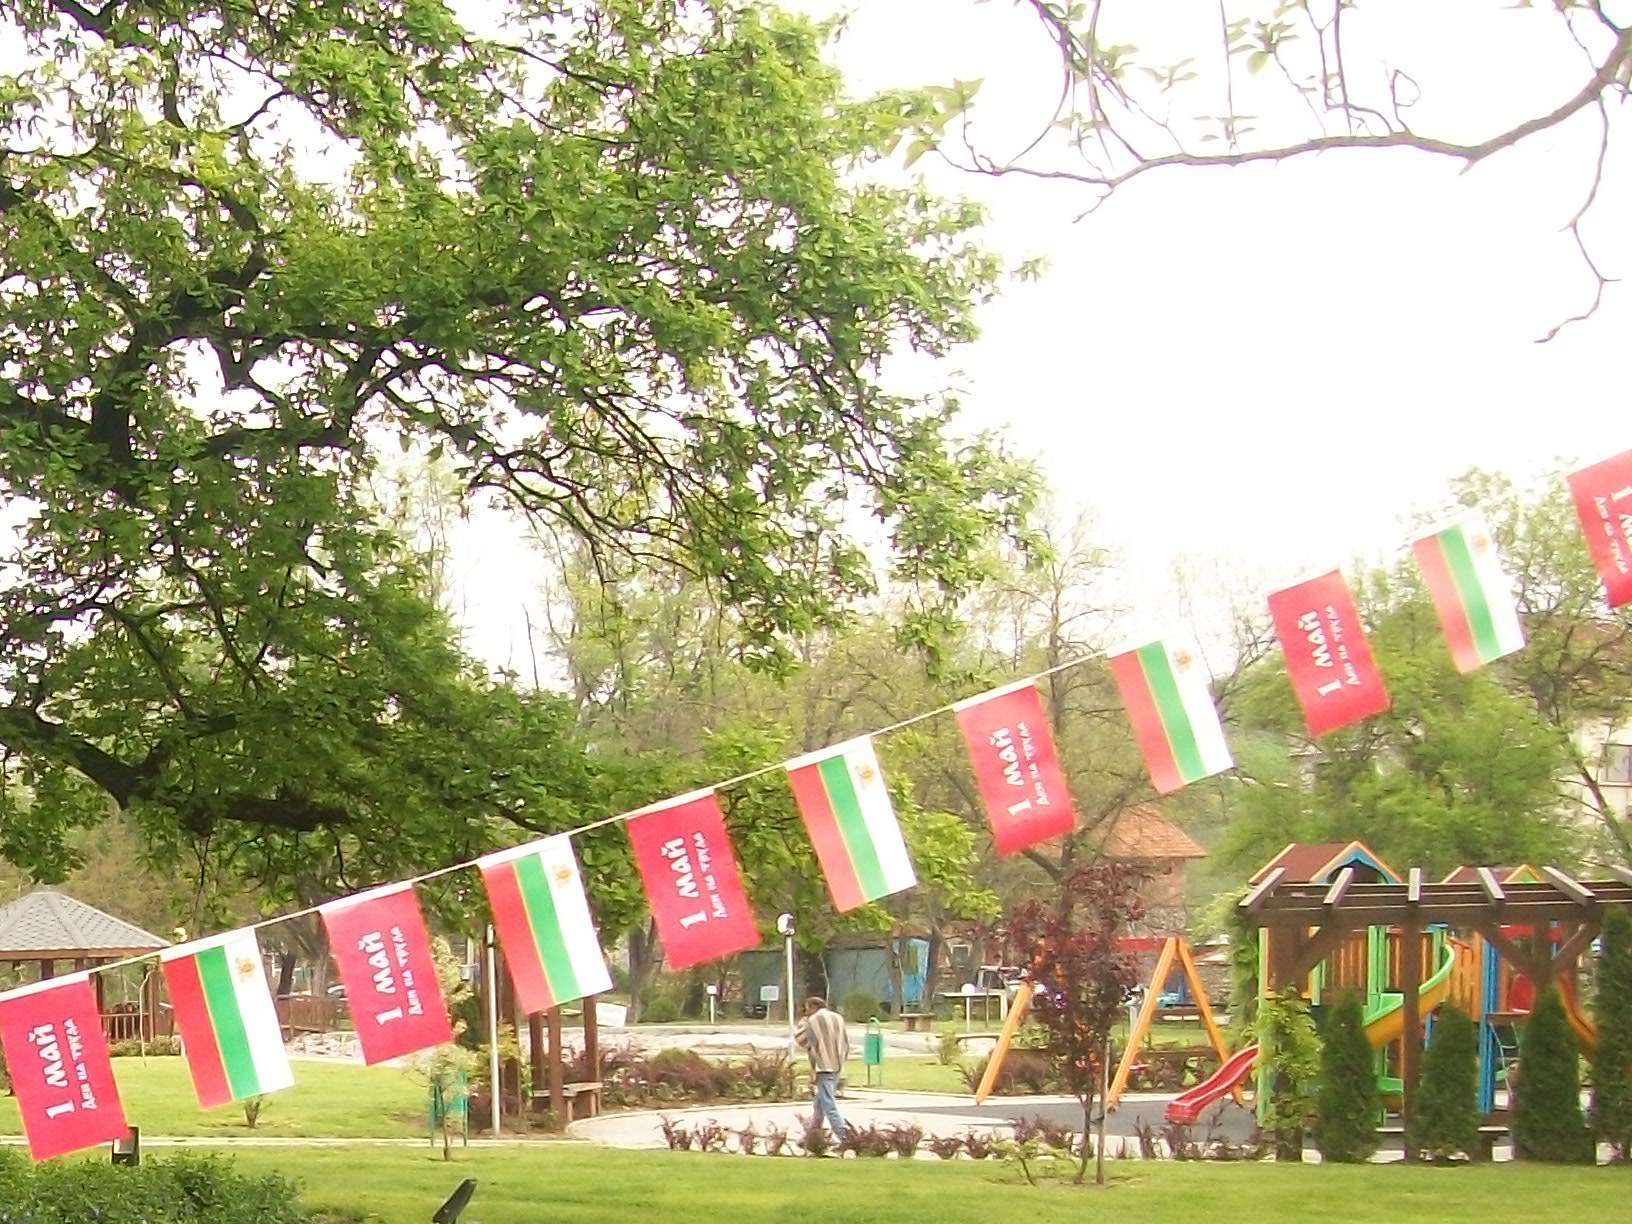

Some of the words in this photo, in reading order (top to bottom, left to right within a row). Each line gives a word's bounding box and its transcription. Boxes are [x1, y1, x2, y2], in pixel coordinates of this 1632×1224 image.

[1297, 611, 1333, 667] май
[1317, 678, 1342, 697] 1
[1017, 722, 1034, 761] труда
[989, 727, 1024, 786] май
[1029, 763, 1039, 779] на
[1034, 781, 1050, 805] Ден
[1007, 798, 1032, 817] 1
[693, 832, 711, 872] труда
[660, 838, 699, 898] май
[704, 874, 717, 891] на
[710, 893, 728, 918] Ден
[679, 910, 708, 929] 1
[390, 926, 409, 968] труда
[357, 931, 396, 994] май
[402, 970, 414, 987] на
[407, 989, 424, 1015] Ден
[375, 1006, 403, 1025] 1
[64, 1018, 84, 1061] труда
[28, 1023, 68, 1087] май
[75, 1062, 88, 1081] на
[45, 1099, 75, 1119] 1
[80, 1083, 98, 1110] Ден
